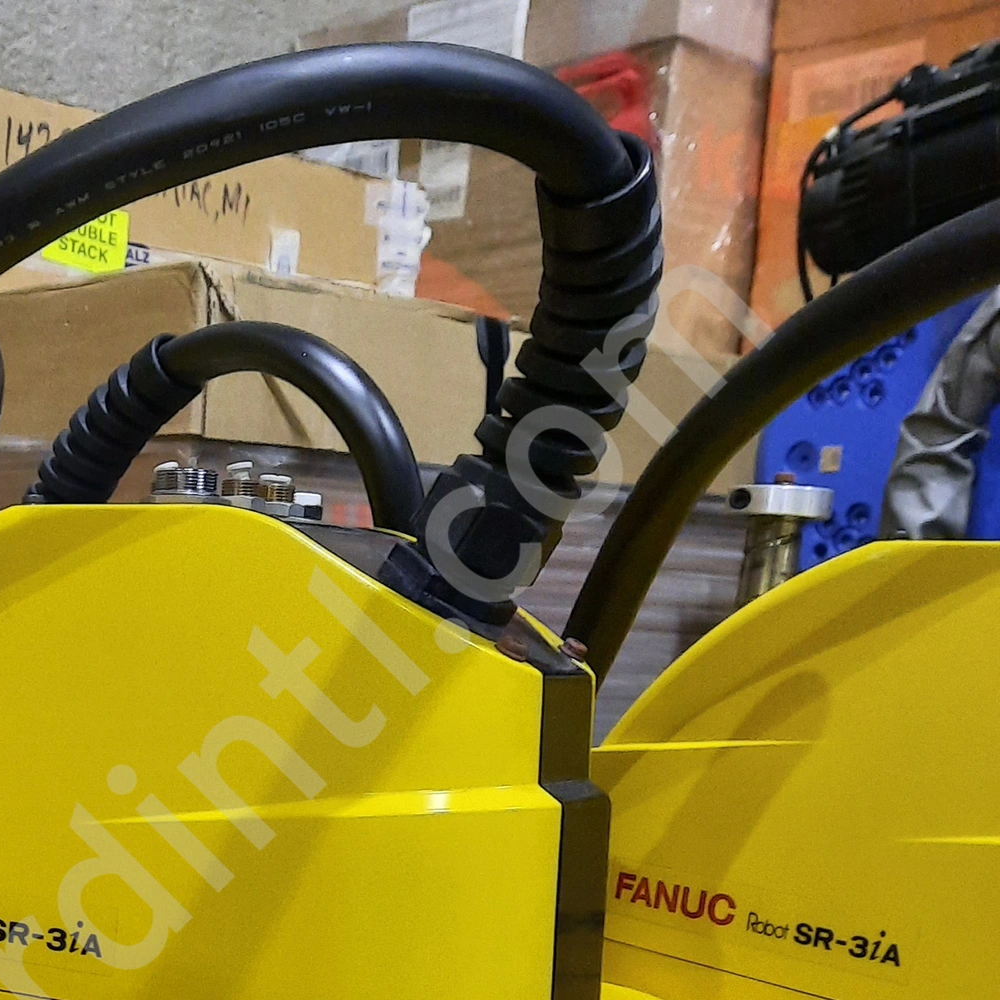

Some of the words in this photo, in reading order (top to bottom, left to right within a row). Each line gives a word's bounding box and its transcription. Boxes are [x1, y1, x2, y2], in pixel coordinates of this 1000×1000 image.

[99, 212, 118, 226] OT
[76, 226, 119, 248] UBLE
[58, 236, 109, 264] STACK
[615, 872, 737, 927] FANUC
[746, 911, 790, 941] Robot
[793, 922, 901, 967] SR-3iA
